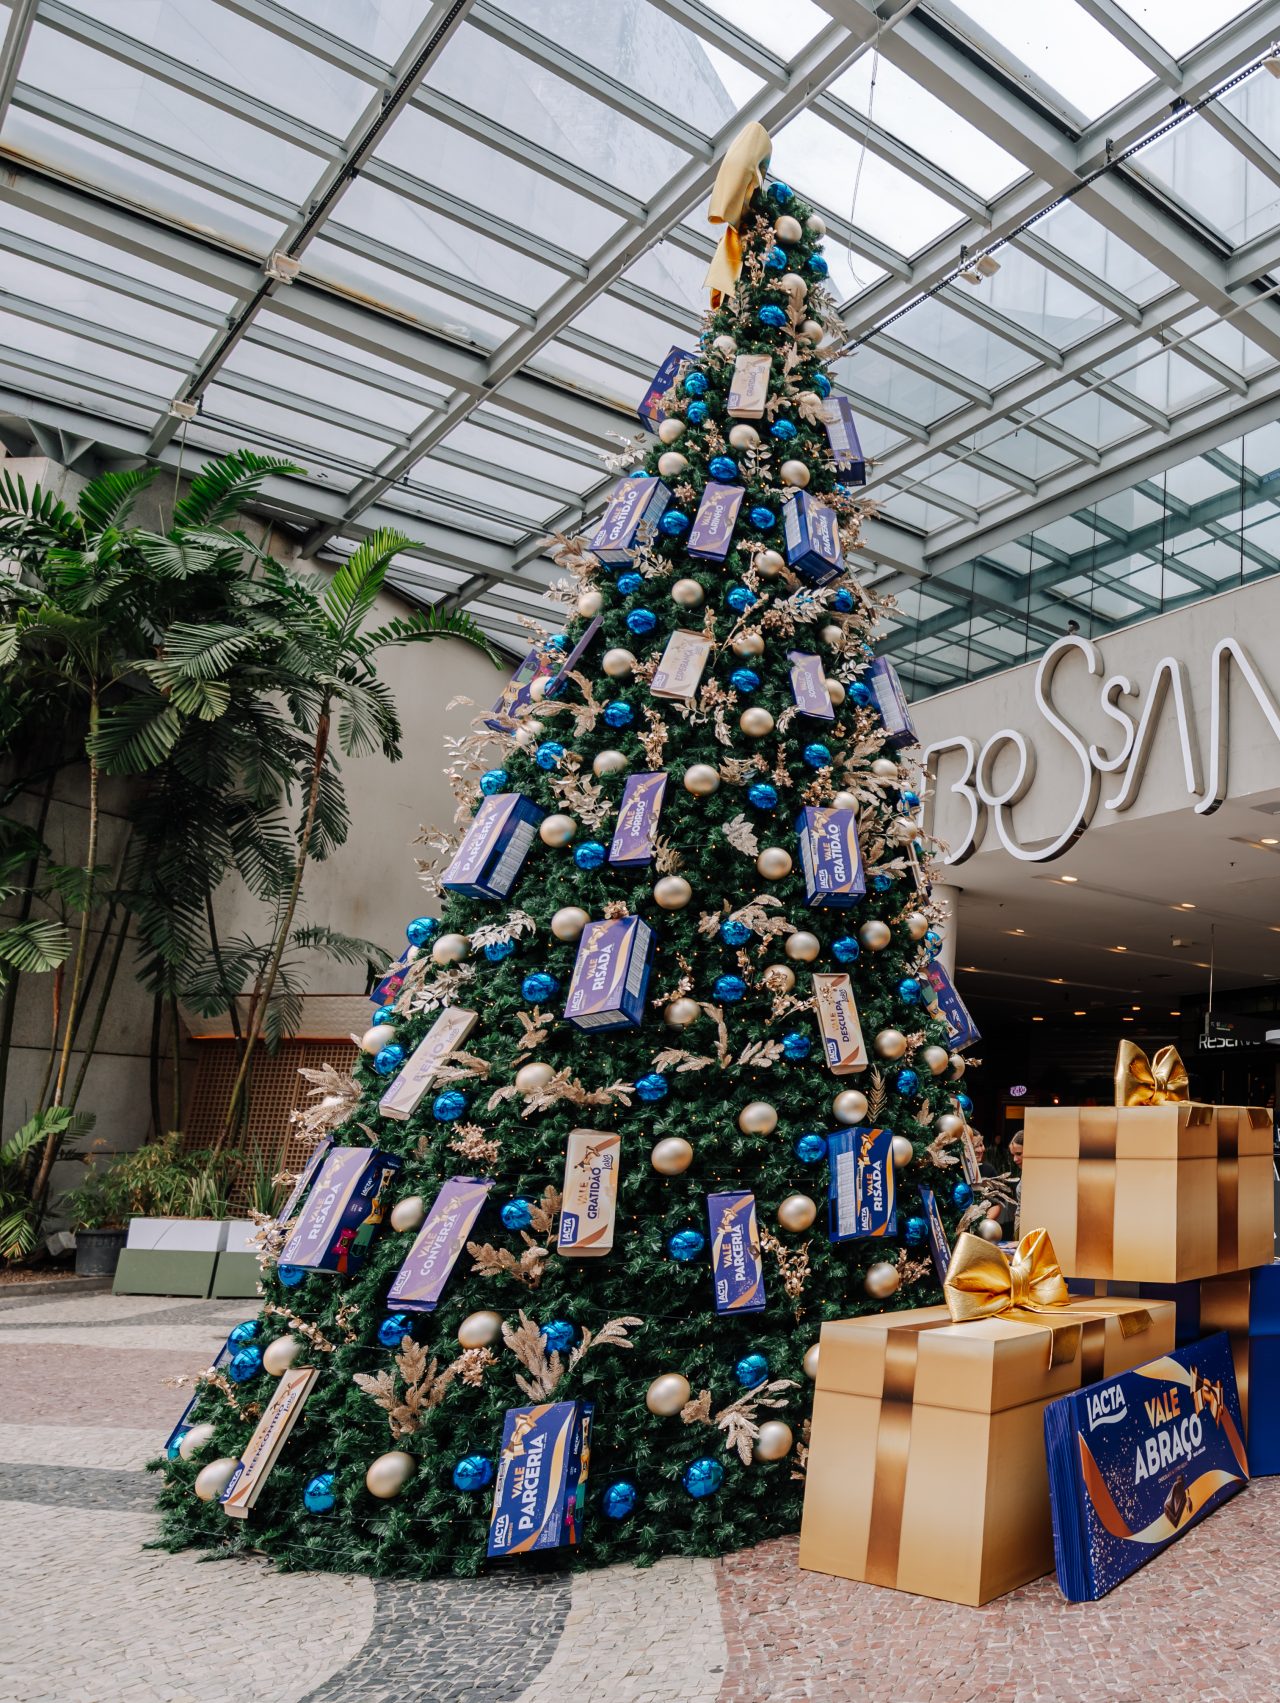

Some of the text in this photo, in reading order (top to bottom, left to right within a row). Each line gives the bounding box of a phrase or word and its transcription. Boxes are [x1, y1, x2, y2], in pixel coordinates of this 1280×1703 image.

[609, 490, 637, 540] GRATIDÃO
[610, 507, 622, 524] VALE
[701, 511, 712, 526] VALE
[708, 504, 724, 535] CARINHO
[623, 810, 635, 831] VALE
[631, 800, 646, 837] SORRISO
[462, 813, 498, 872] PARCERIA
[610, 838, 623, 858] LACTA
[823, 842, 832, 862] VALE
[827, 823, 846, 883] GRATIDÃO
[819, 869, 829, 889] LACTA
[586, 958, 598, 980] VALE
[592, 943, 614, 991] RISADA
[570, 989, 584, 1012] LACTA
[835, 1000, 850, 1043] DESCULPA
[828, 1041, 839, 1062] LACTA
[360, 1178, 376, 1197] LACTA
[587, 1166, 602, 1220] GRATIDÃO
[871, 1159, 883, 1212] RISADA
[307, 1182, 343, 1240] RISADA
[861, 1206, 870, 1231] LACTA
[420, 1213, 458, 1277] CONVERSA
[561, 1217, 576, 1242] LACTA
[283, 1234, 302, 1262] LACTA
[416, 1232, 438, 1259] VALE
[721, 1243, 733, 1268] VALE
[731, 1223, 746, 1282] PARCERIA
[390, 1269, 412, 1295] LACTA
[718, 1279, 729, 1303] LACTA
[1085, 1383, 1128, 1433] LACTA
[1143, 1386, 1181, 1430] VALE
[245, 1402, 285, 1477] REENCONTRO
[1133, 1412, 1204, 1486] ABRAÇO
[224, 1468, 243, 1498] LACTA
[511, 1466, 526, 1500] VALE
[518, 1433, 546, 1531] PARCERIA
[493, 1513, 509, 1549] LACTA
